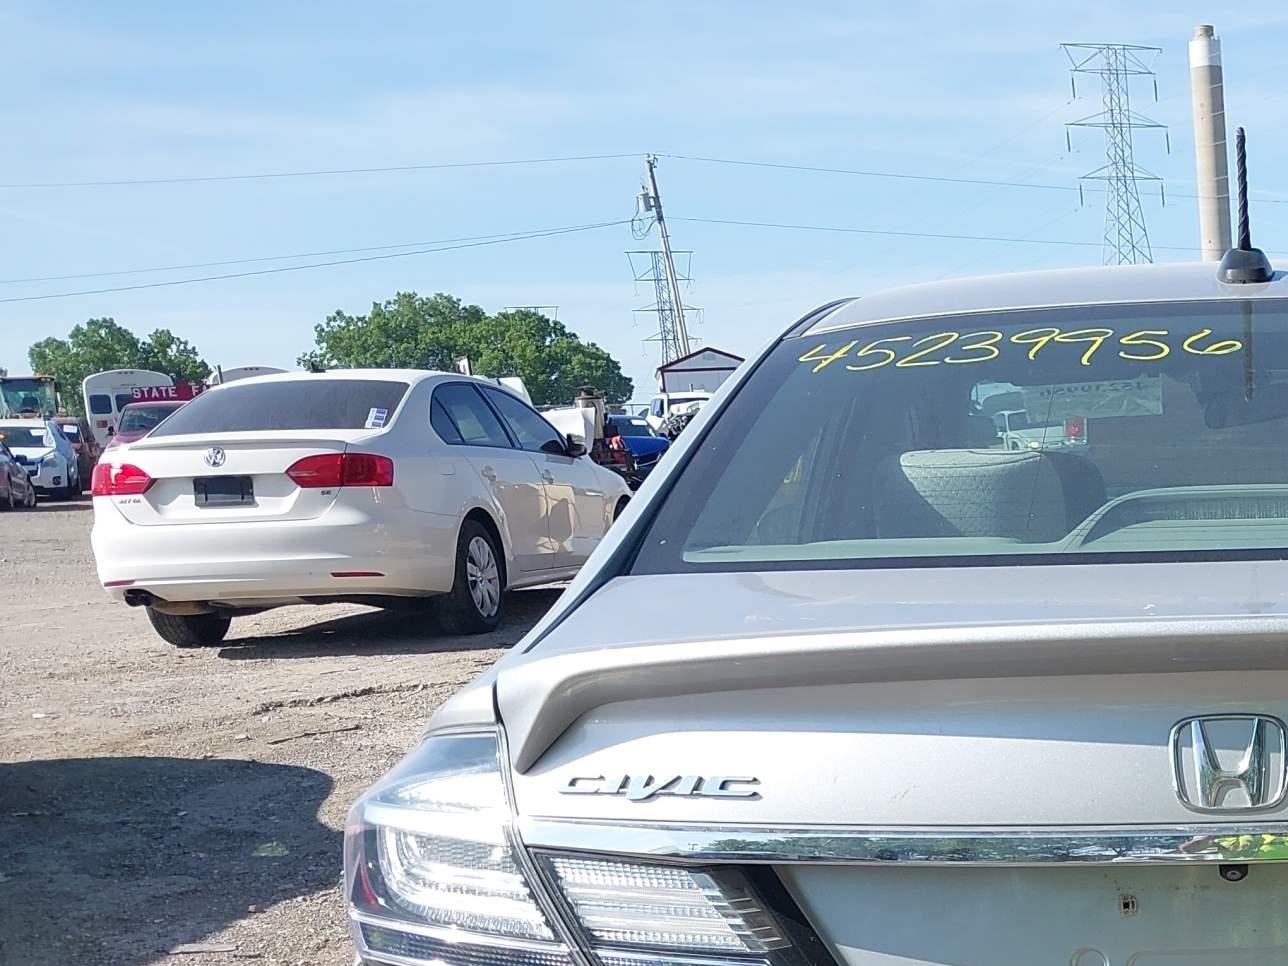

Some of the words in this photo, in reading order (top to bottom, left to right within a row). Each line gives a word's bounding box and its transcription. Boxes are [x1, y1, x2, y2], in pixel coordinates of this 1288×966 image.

[799, 327, 1242, 373] 45239956
[131, 386, 178, 399] STATE
[558, 774, 764, 804] CIVIC
